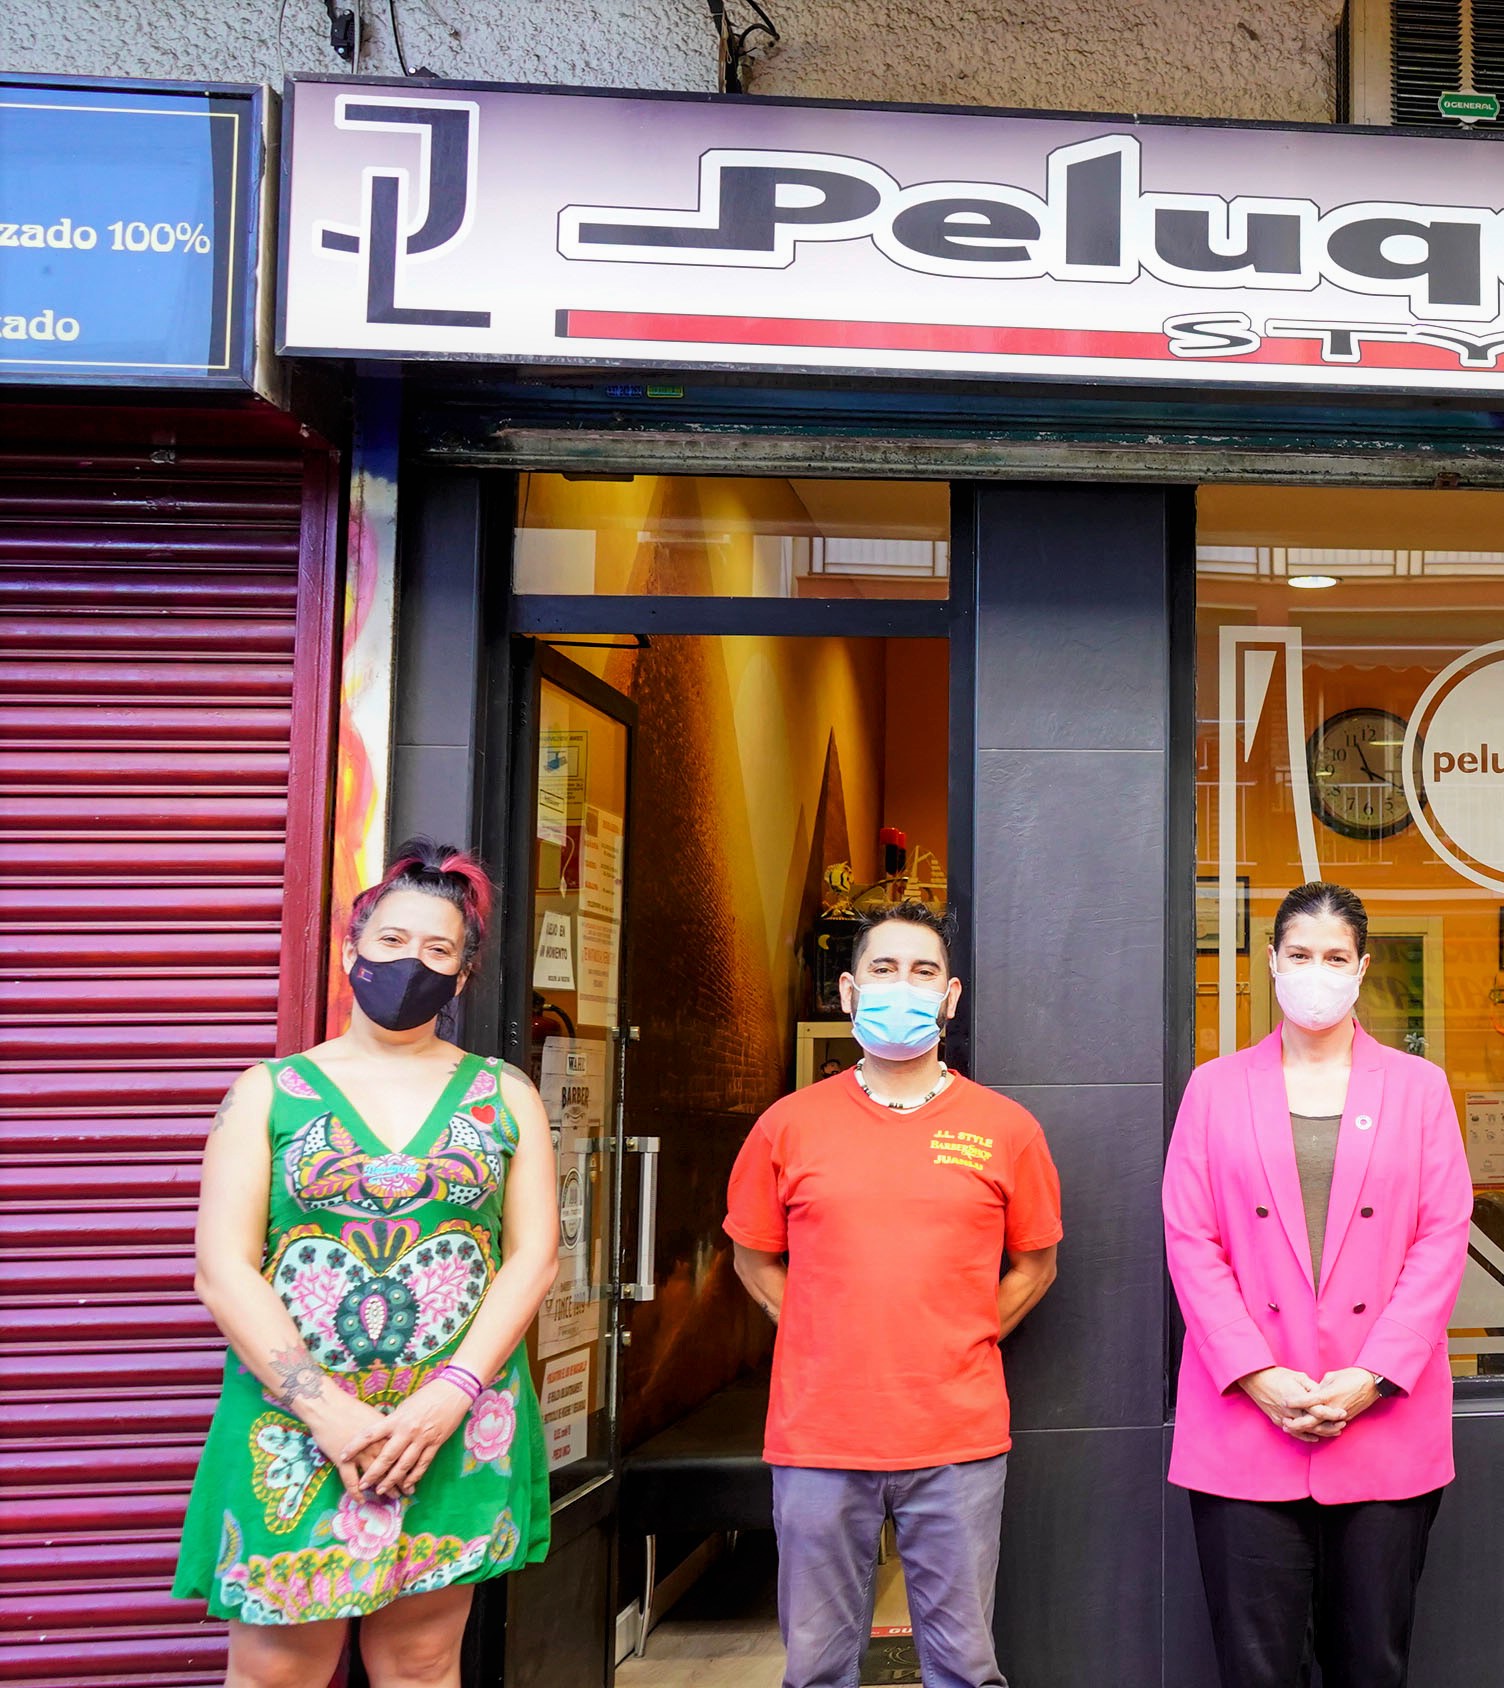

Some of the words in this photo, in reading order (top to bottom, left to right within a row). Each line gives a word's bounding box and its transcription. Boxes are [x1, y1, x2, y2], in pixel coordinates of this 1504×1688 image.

[107, 221, 211, 254] 100%
[0, 310, 80, 341] ado
[957, 1131, 993, 1148] STYLE
